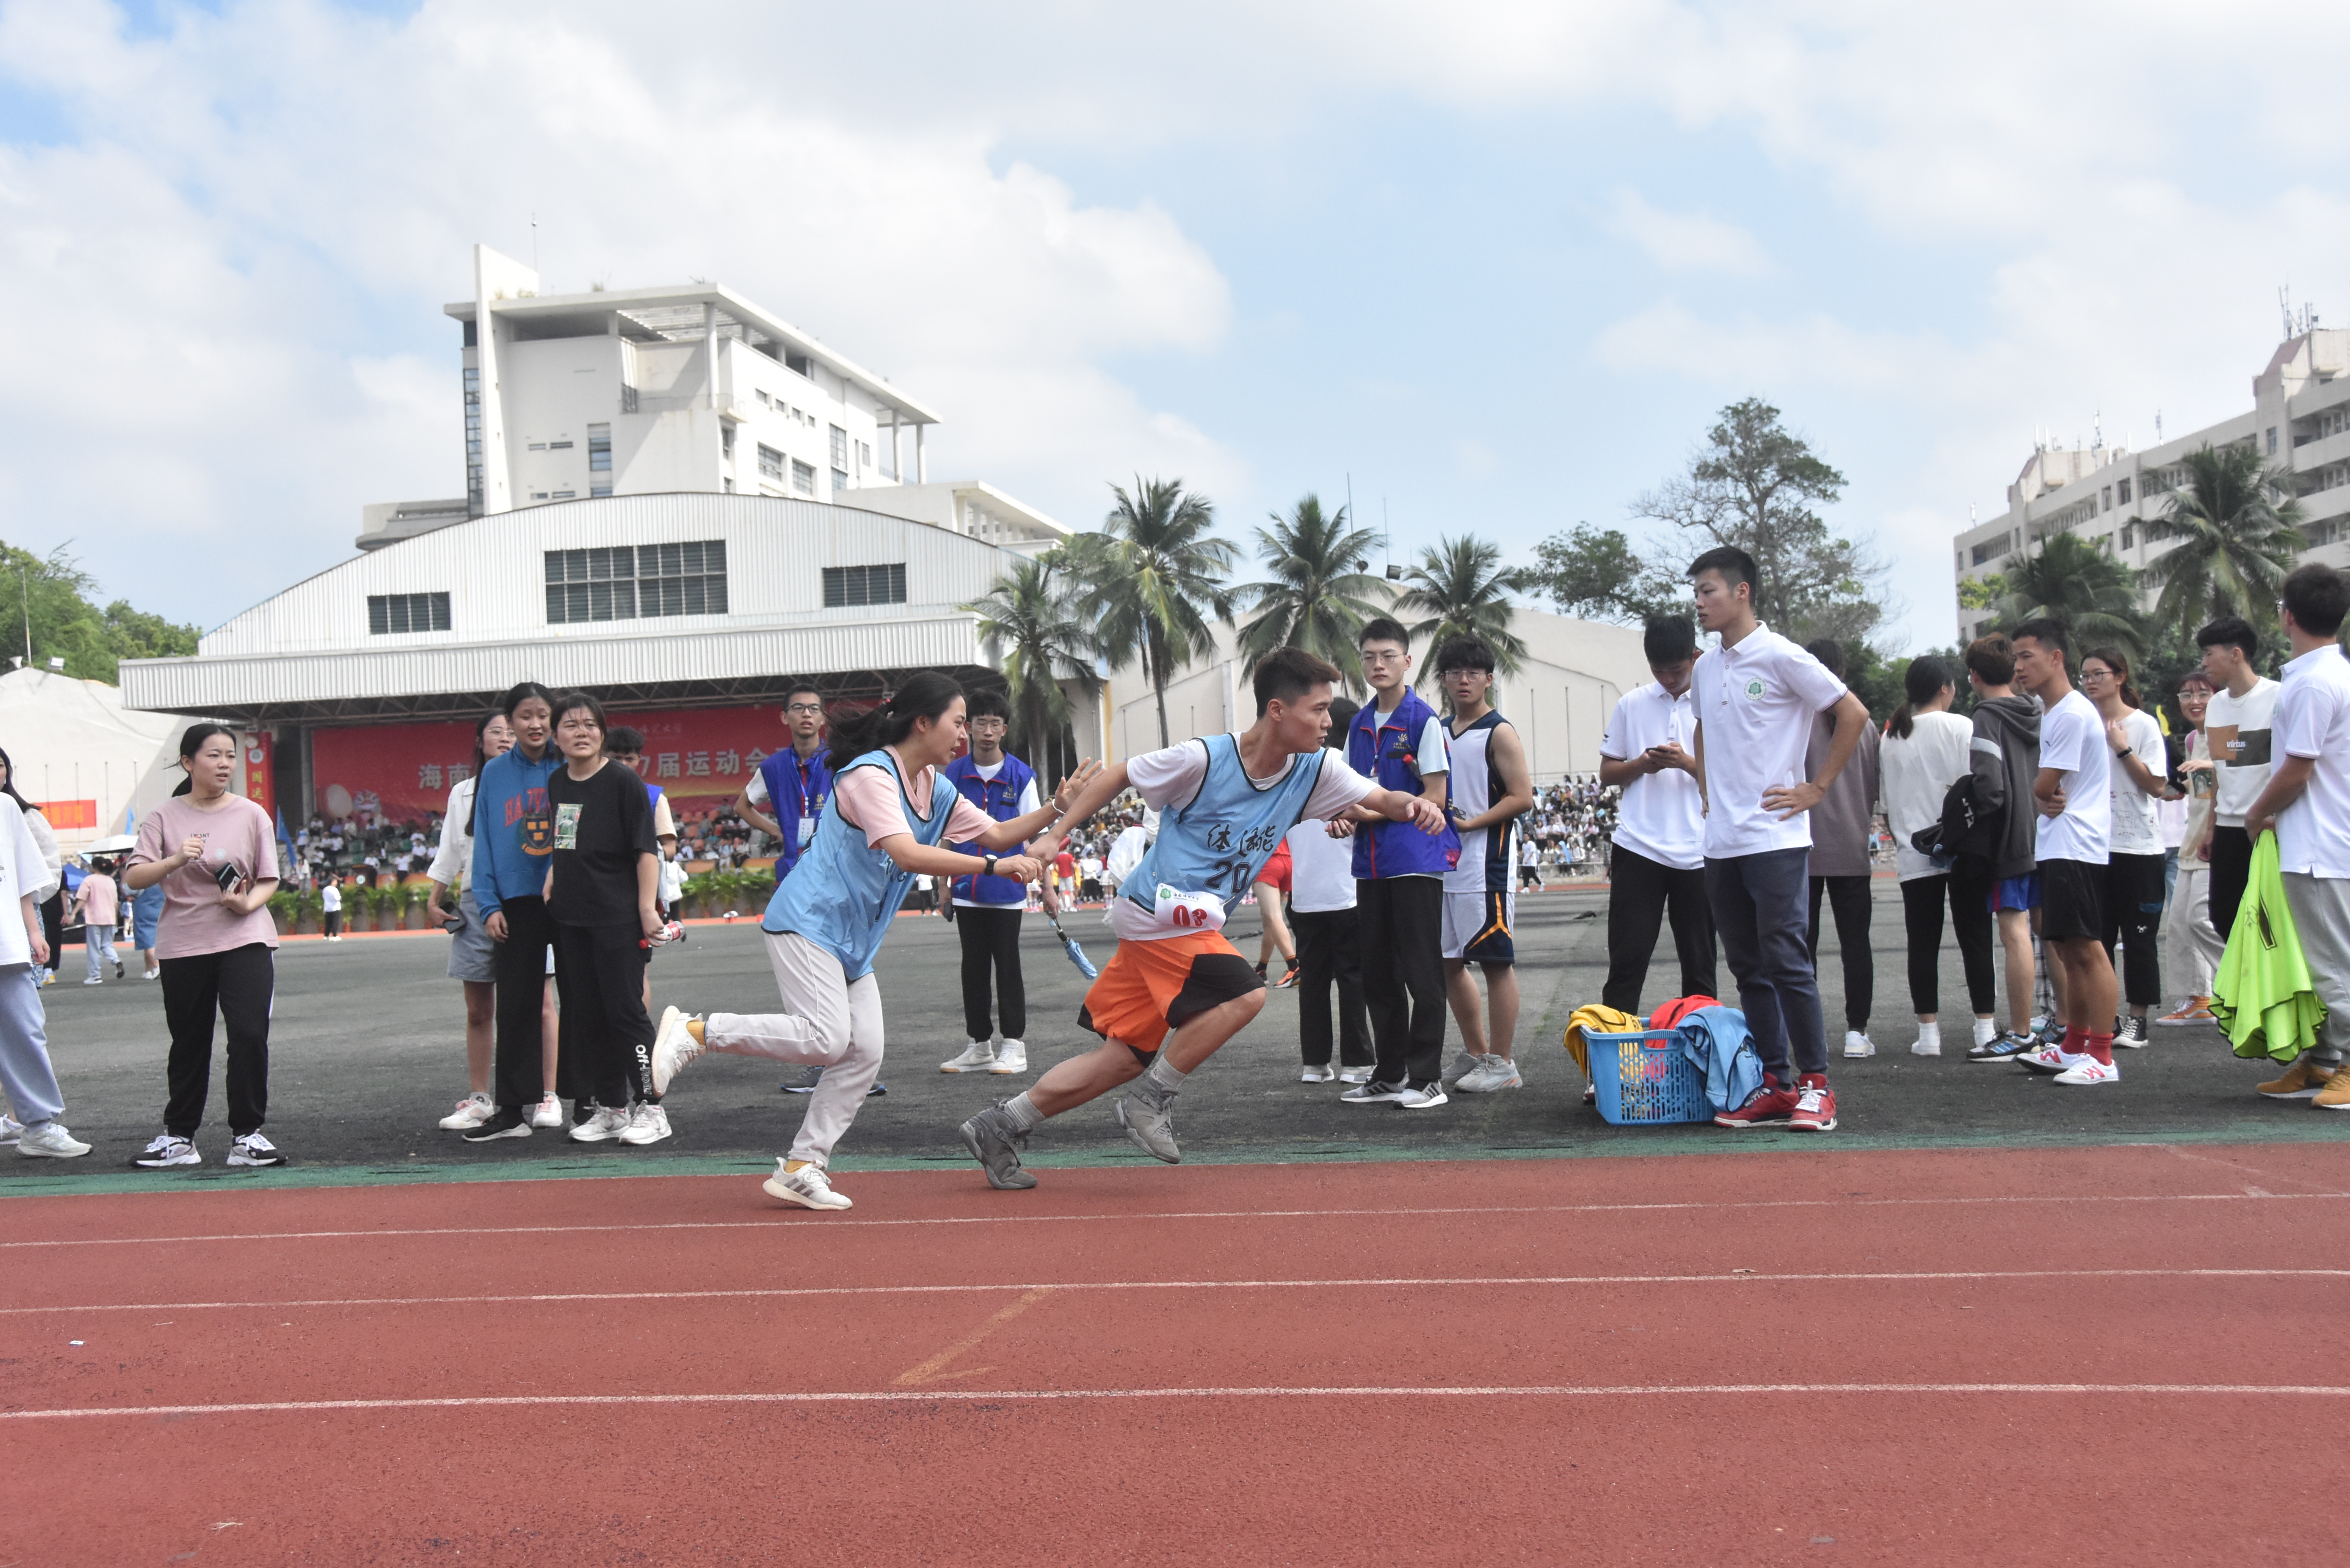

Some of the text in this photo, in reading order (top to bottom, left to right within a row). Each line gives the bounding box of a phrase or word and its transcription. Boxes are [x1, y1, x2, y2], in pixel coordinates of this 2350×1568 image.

[419, 747, 789, 790] 海南 7届运动会
[1203, 860, 1252, 895] 20
